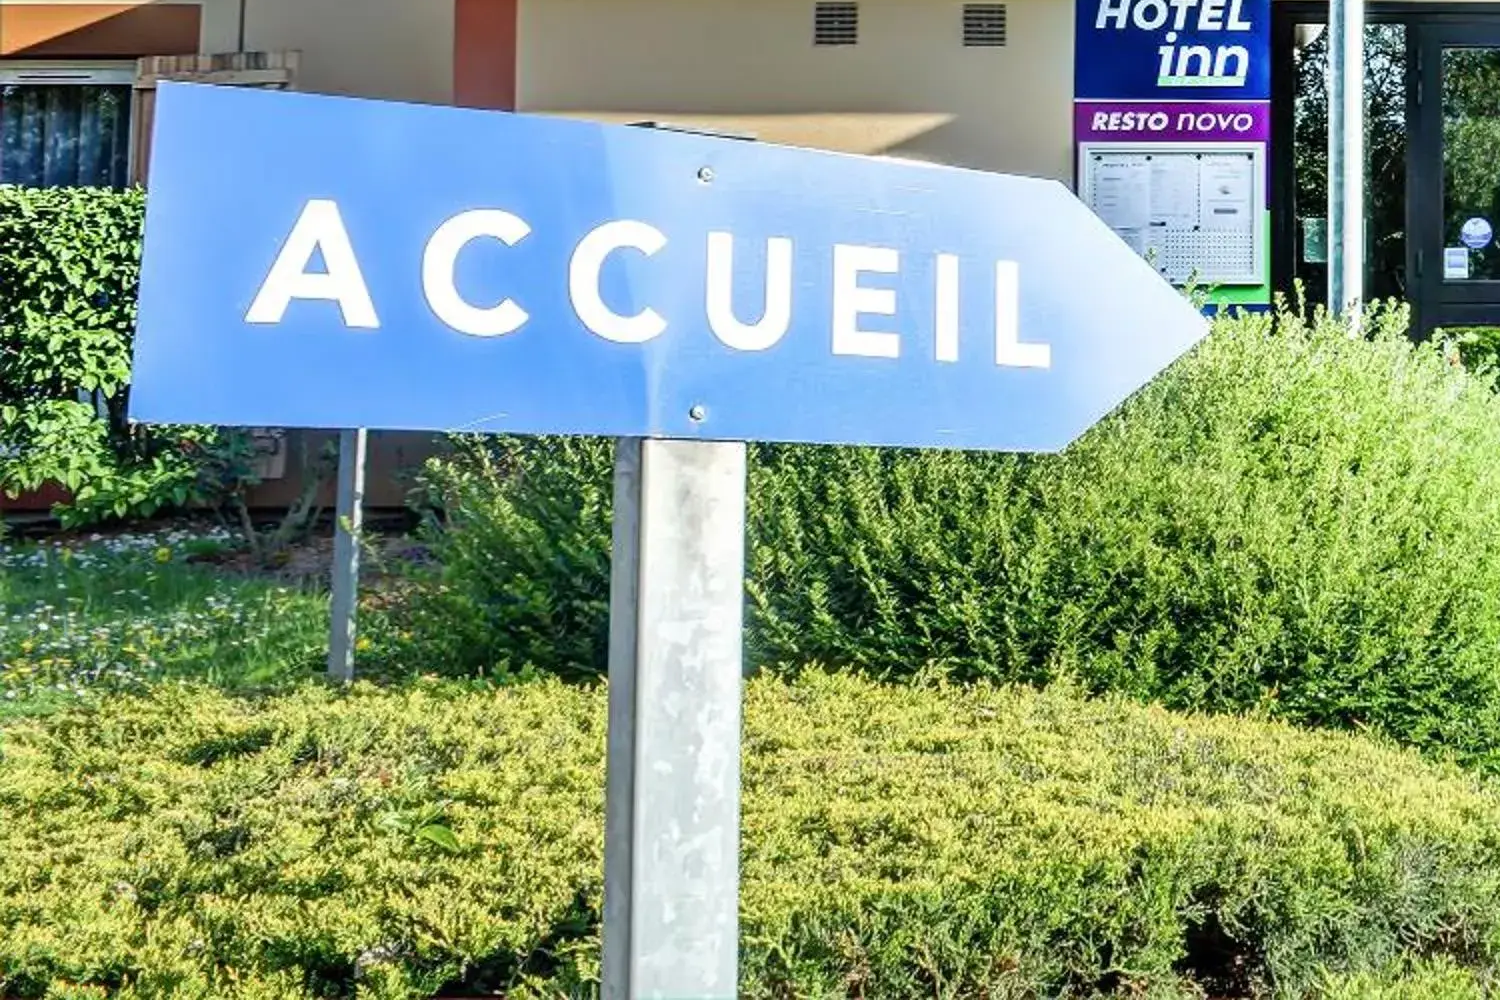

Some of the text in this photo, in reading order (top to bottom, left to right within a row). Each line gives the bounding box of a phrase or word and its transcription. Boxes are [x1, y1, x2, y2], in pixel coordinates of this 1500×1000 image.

[1158, 31, 1250, 77] inn
[1091, 111, 1169, 131] RESTO
[244, 199, 1052, 370] ACCUEIL
